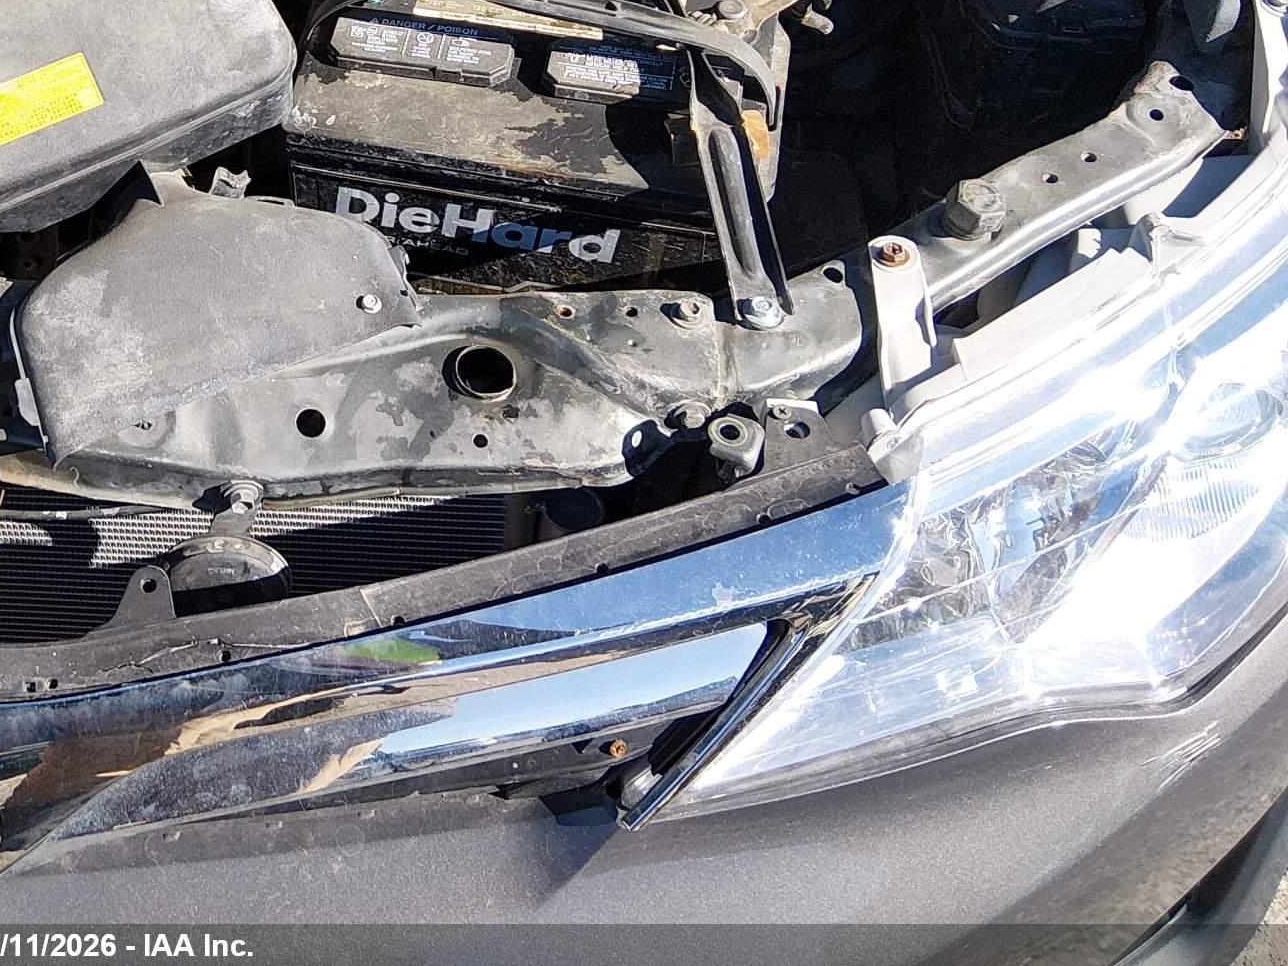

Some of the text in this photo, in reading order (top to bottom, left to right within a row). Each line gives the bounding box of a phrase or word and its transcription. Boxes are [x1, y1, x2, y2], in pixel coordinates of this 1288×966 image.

[381, 17, 429, 32] DANGER
[437, 24, 479, 36] POISON
[335, 185, 622, 264] DieHard
[402, 237, 469, 256] AHEAD
